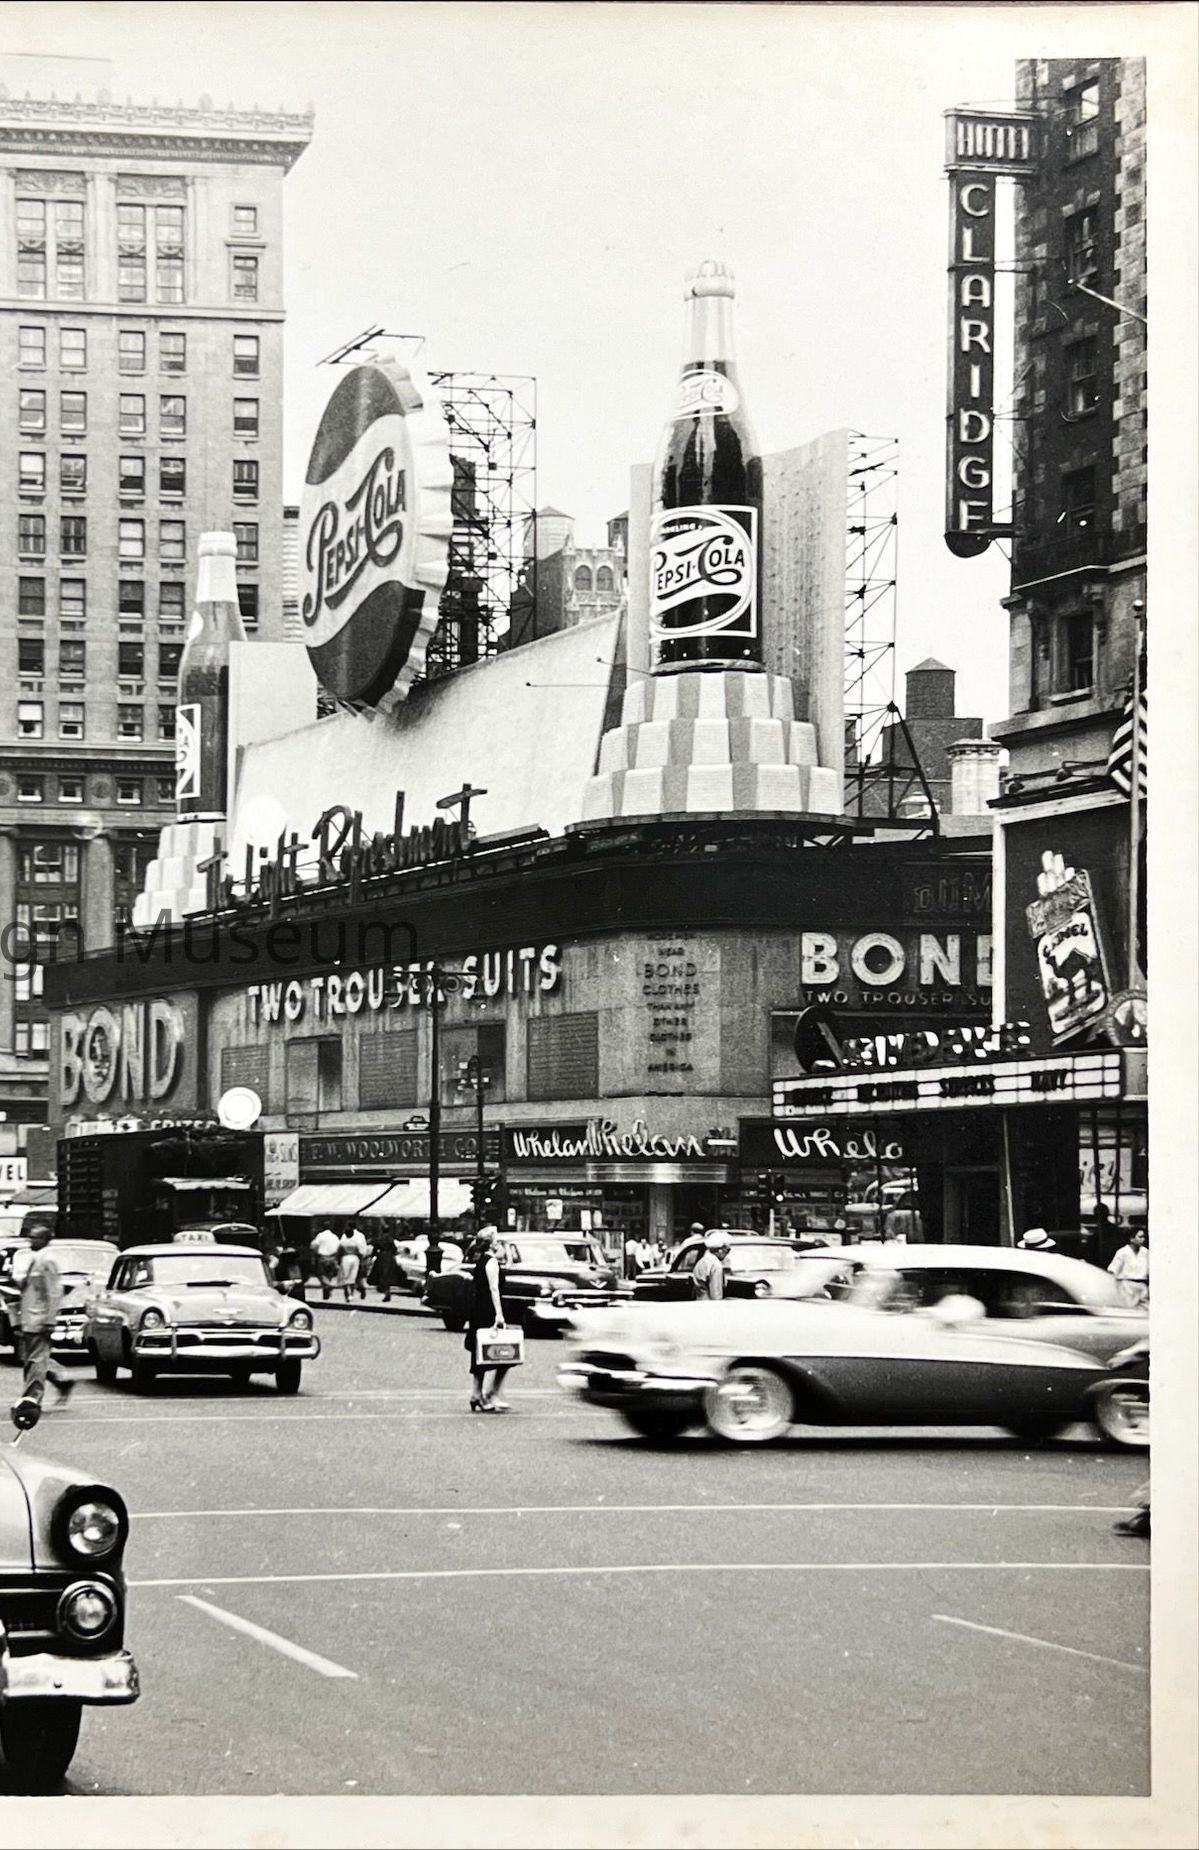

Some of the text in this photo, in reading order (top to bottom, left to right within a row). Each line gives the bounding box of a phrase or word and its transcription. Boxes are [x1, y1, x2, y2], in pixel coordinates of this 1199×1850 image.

[959, 184, 991, 531] CLARIDGE
[247, 980, 302, 1023] TWO
[462, 944, 559, 1000] SUITS
[642, 983, 700, 996] CLOTHES
[644, 962, 697, 979] BOND
[806, 990, 848, 1004] TWO
[861, 991, 954, 1006] TROUSER
[60, 999, 184, 1106] BOND
[586, 1118, 706, 1158] Whelan
